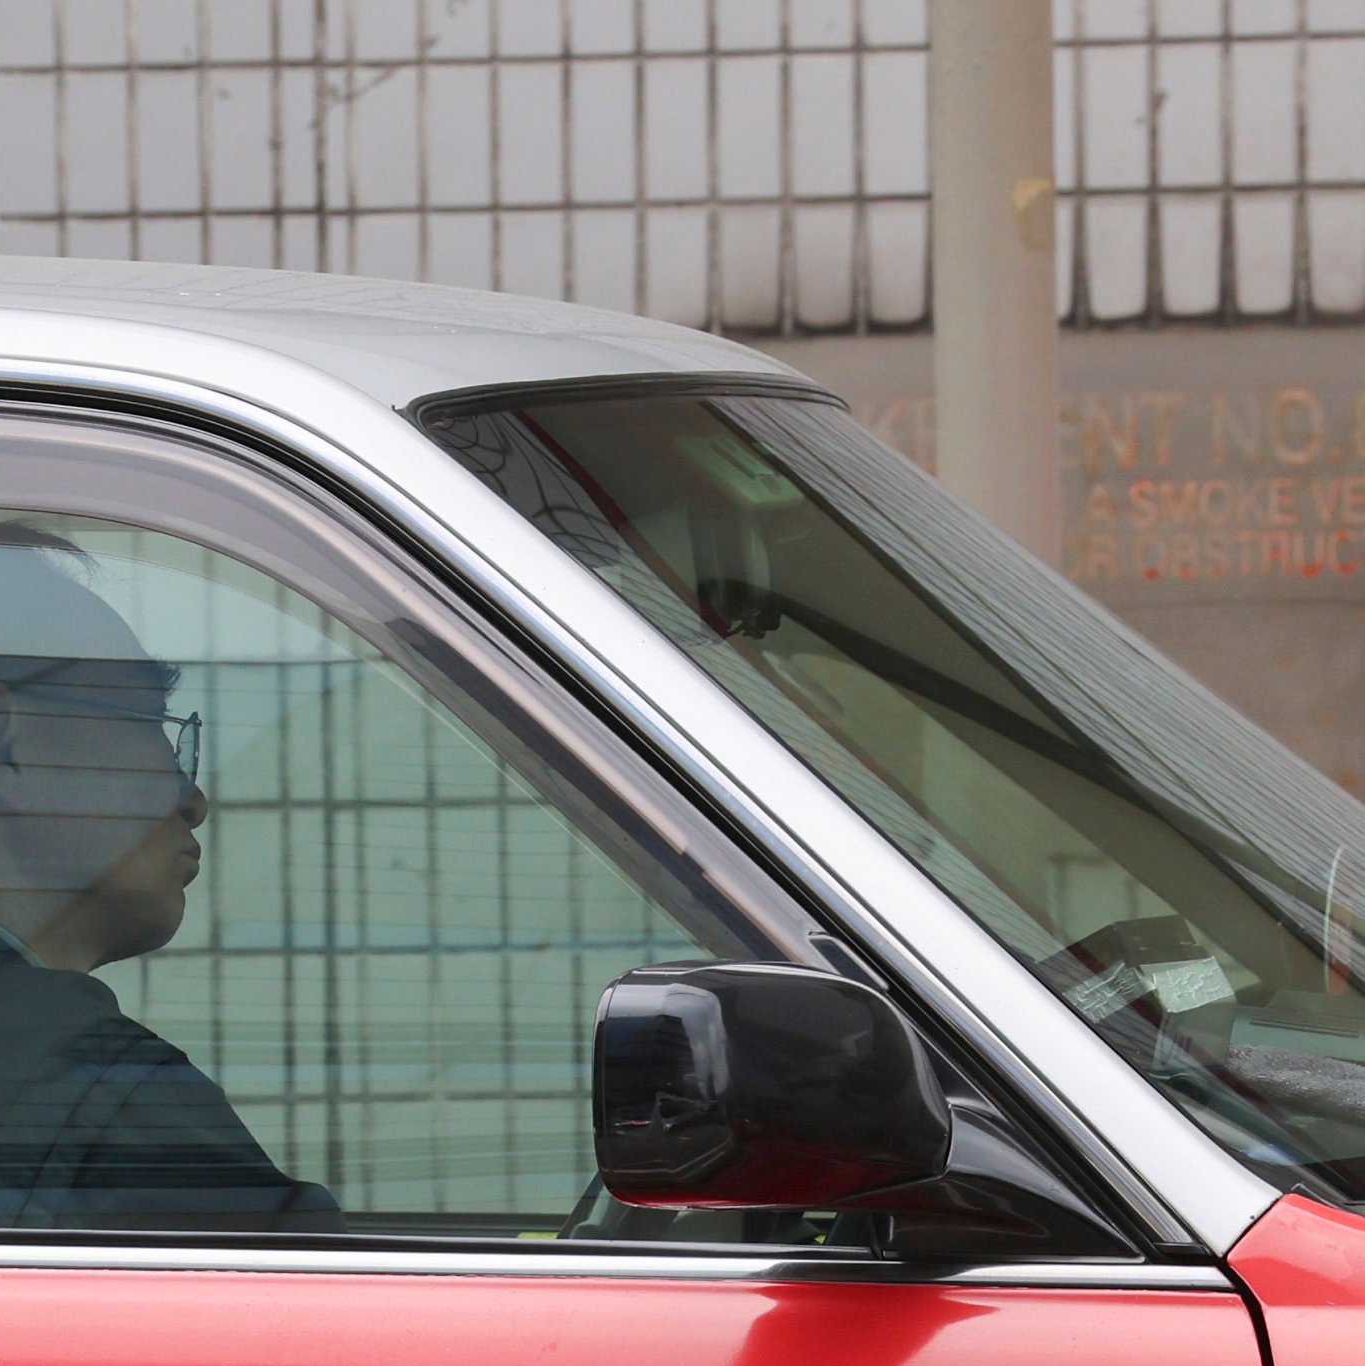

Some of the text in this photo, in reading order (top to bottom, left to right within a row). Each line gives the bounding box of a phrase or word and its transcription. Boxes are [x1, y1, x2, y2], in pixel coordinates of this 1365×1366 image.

[1211, 387, 1365, 468] NO.
[1128, 479, 1299, 528] SMOKE
[1131, 530, 1365, 581] OBSTRUC
